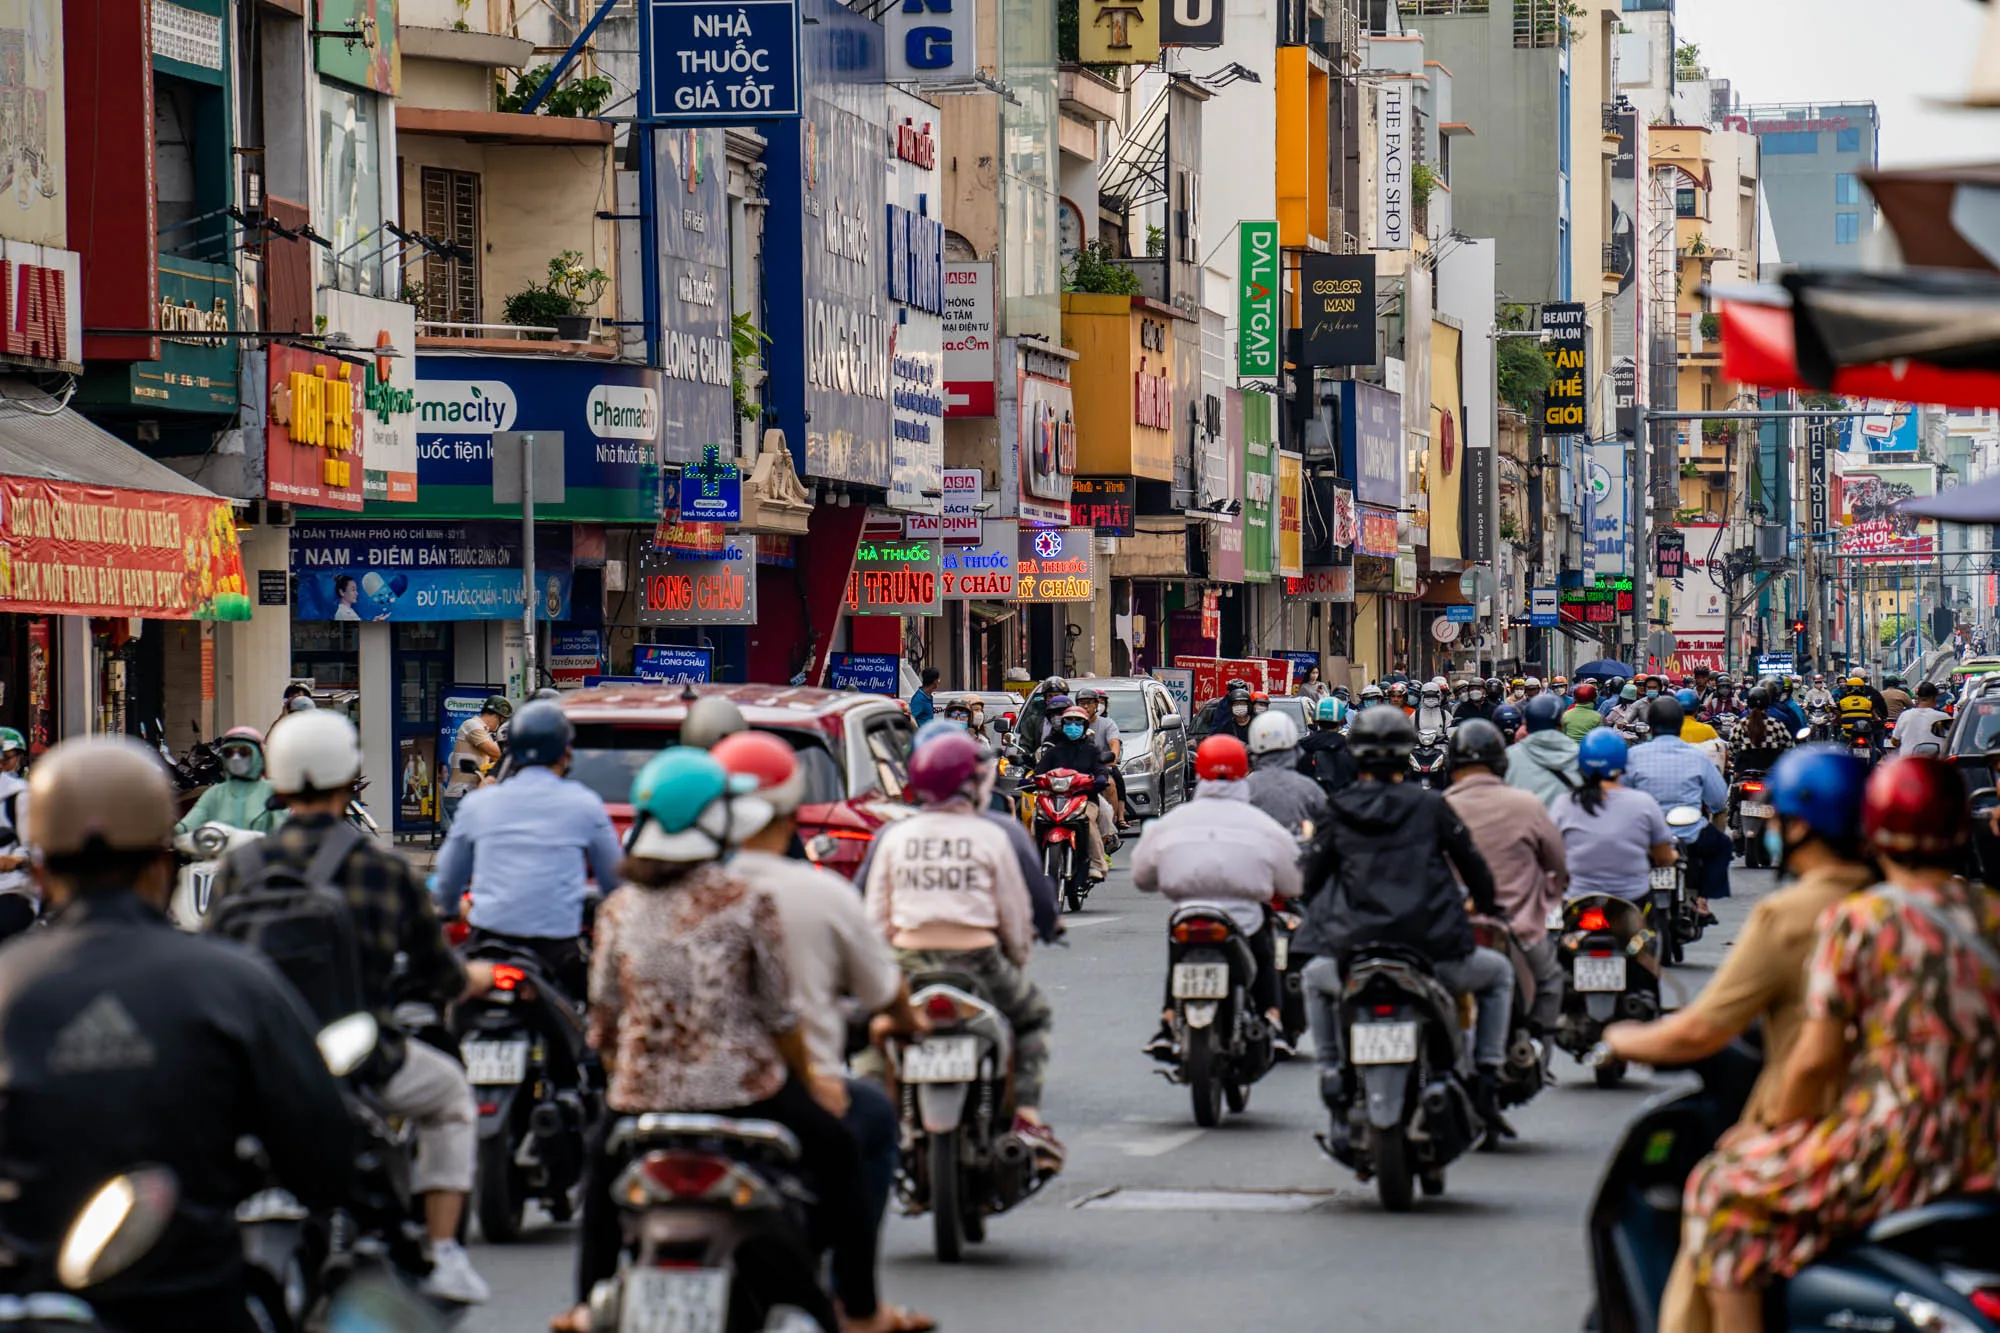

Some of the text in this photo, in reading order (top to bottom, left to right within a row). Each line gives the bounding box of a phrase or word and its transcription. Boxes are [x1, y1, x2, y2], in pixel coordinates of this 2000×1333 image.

[694, 8, 752, 38] NHÀ
[677, 39, 770, 73] THUỐC
[675, 75, 774, 110] GIÁ TỐT
[1386, 86, 1402, 243] THE FACE SHOP
[1312, 280, 1362, 295] COLOR
[1251, 231, 1271, 366] DALATGAP
[1324, 298, 1355, 312] MAN
[1543, 311, 1582, 324] BEAUTY
[664, 323, 731, 388] LONG CHÂU
[808, 294, 888, 401] LONG CHÂU
[1546, 403, 1583, 424] GIỚI
[454, 441, 483, 463] tiện
[305, 548, 350, 565] NAM
[368, 544, 414, 565] ĐIỂM
[418, 544, 446, 565] BÁN
[881, 545, 931, 561] THUỐC
[963, 551, 1009, 568] THUỐC
[1659, 547, 1681, 562] NỐI
[1042, 556, 1088, 574] THUỐC
[1662, 564, 1678, 576] MI
[647, 564, 745, 611] LONG CHÂU
[863, 563, 935, 605] TRƯNG
[960, 571, 1012, 594] CHÂU
[1040, 576, 1091, 597] CHÂU
[416, 584, 437, 607] ĐỦ
[675, 649, 696, 658] THUỐC
[684, 658, 705, 667] CHÂU
[875, 664, 894, 673] CHÂU
[906, 837, 971, 861] DEAD
[896, 866, 976, 891] INSIDE
